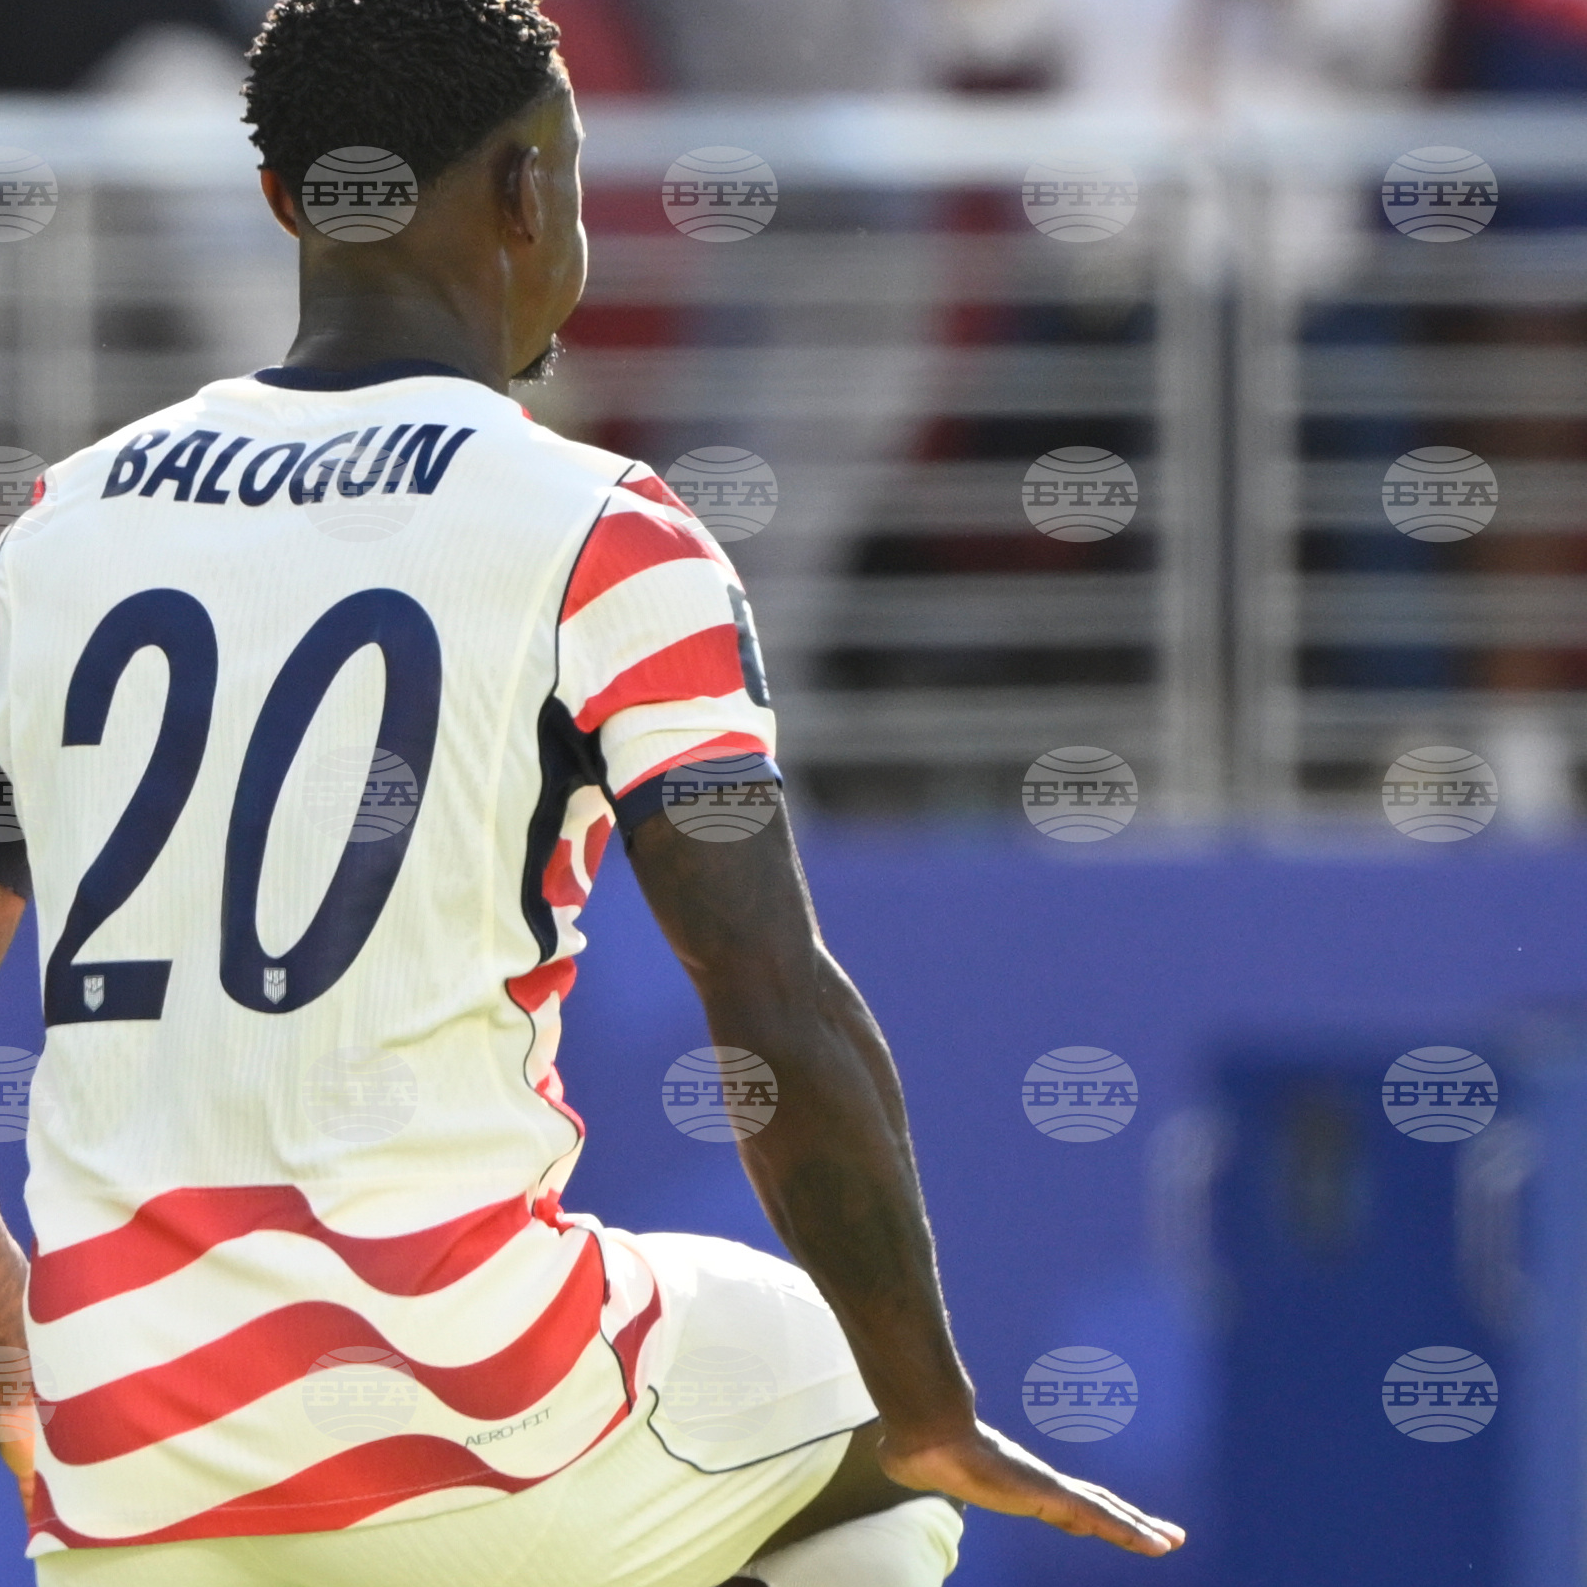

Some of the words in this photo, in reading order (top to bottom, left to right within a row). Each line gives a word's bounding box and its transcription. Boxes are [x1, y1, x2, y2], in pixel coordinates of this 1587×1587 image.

[100, 423, 478, 507] BALOGUN
[44, 587, 443, 1027] 20
[464, 1406, 551, 1449] AERO-FIT
